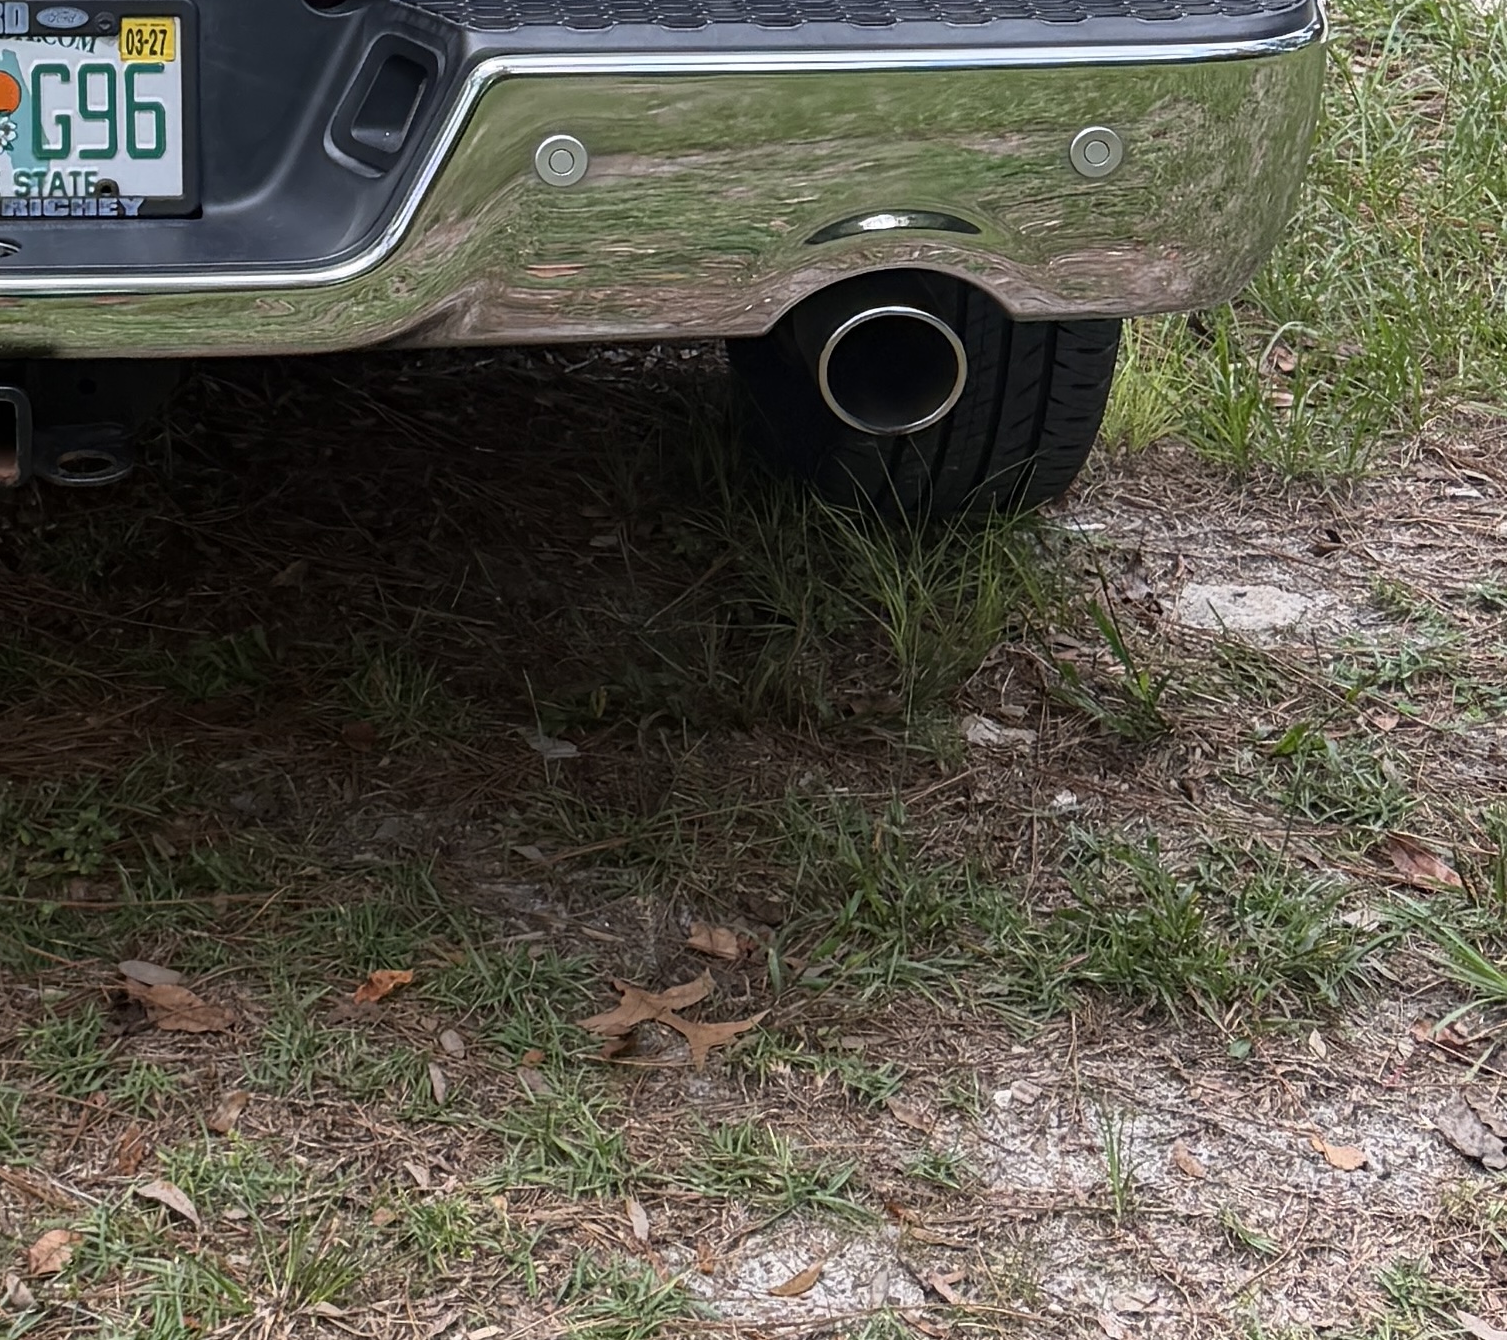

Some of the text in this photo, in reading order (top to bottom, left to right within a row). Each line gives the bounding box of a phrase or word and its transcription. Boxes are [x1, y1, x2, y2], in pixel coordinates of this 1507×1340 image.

[126, 28, 168, 56] 03-27
[31, 63, 167, 160] G96
[13, 171, 98, 197] STATE
[1, 197, 144, 217] RICHEY
